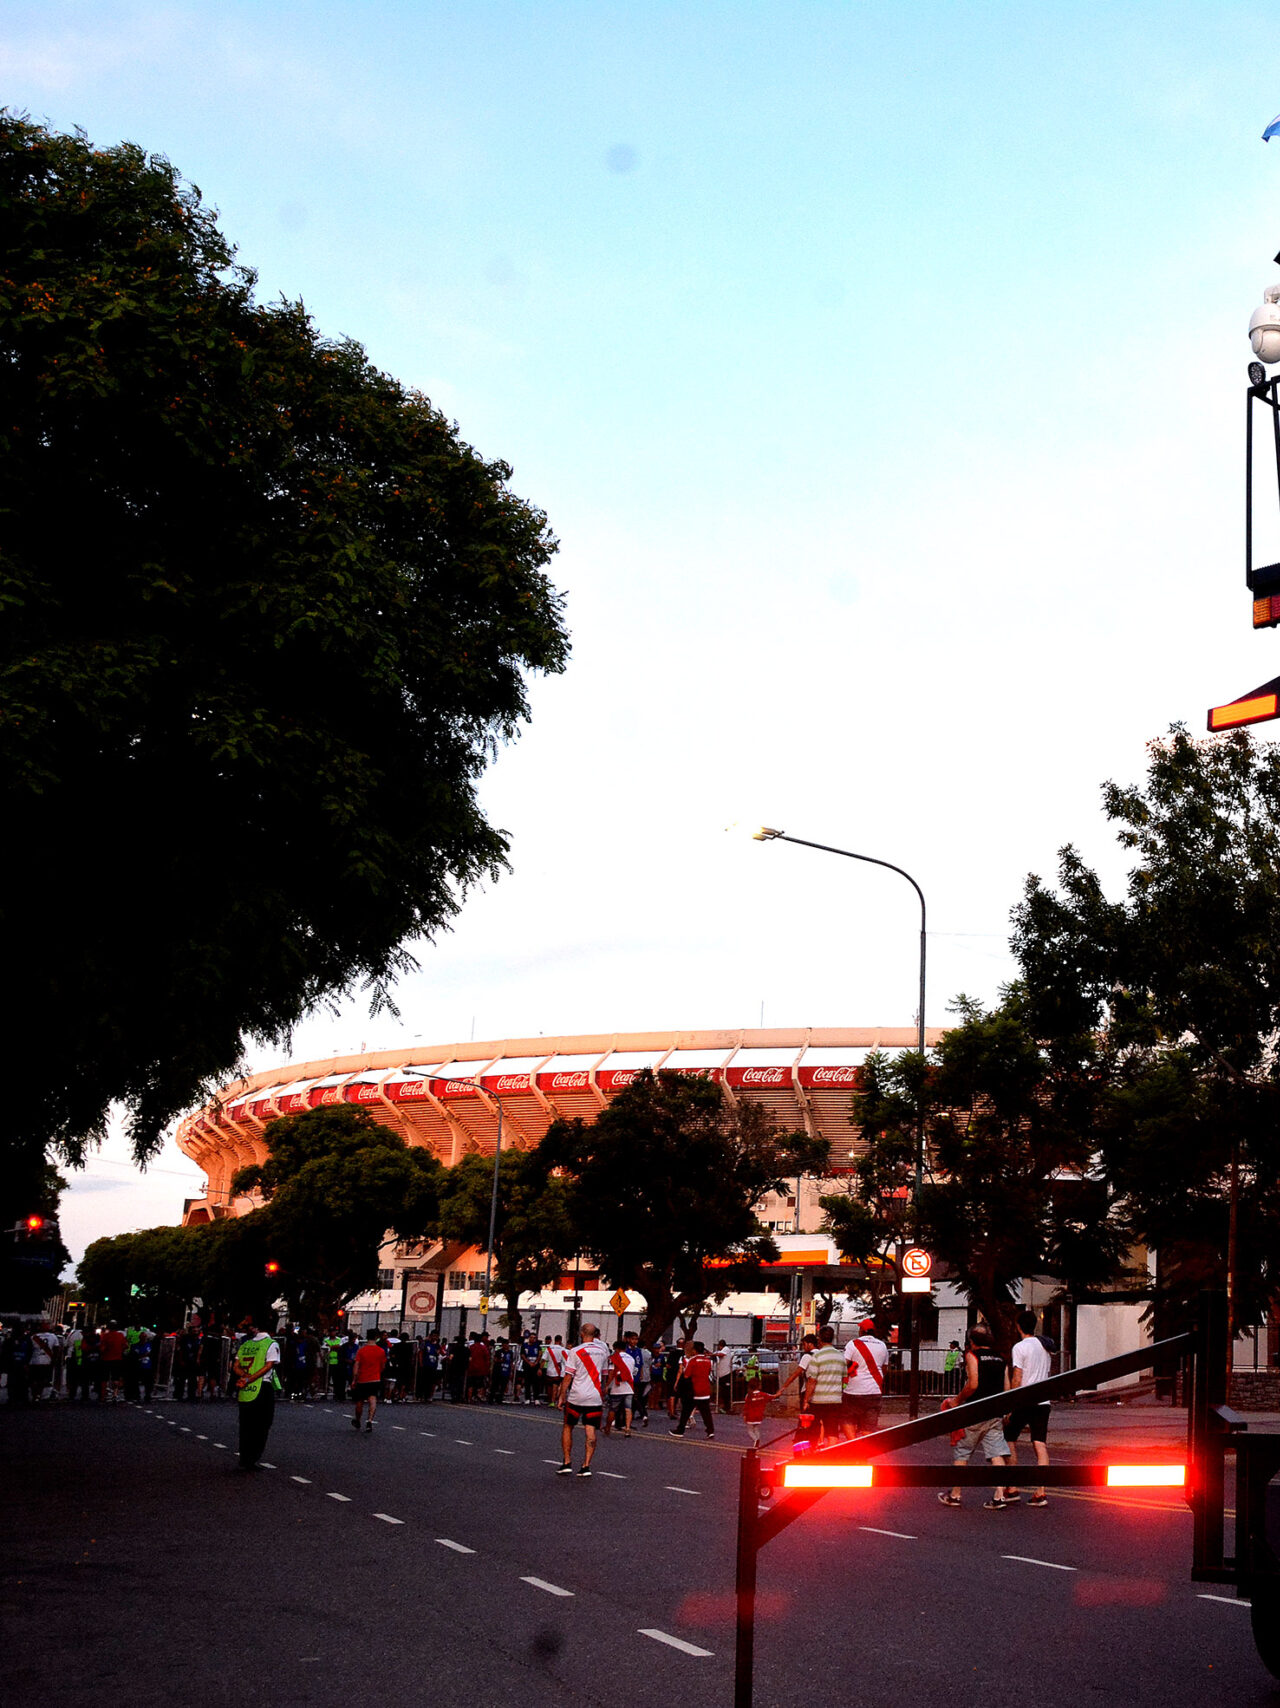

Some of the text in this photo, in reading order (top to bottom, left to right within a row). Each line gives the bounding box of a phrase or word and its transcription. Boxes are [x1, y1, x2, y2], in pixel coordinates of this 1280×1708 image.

[497, 1074, 530, 1090] Coca-Cola
[552, 1072, 588, 1088] Coca-Cola
[742, 1067, 786, 1082] Coca-Cola
[812, 1066, 858, 1082] Coca-Cola
